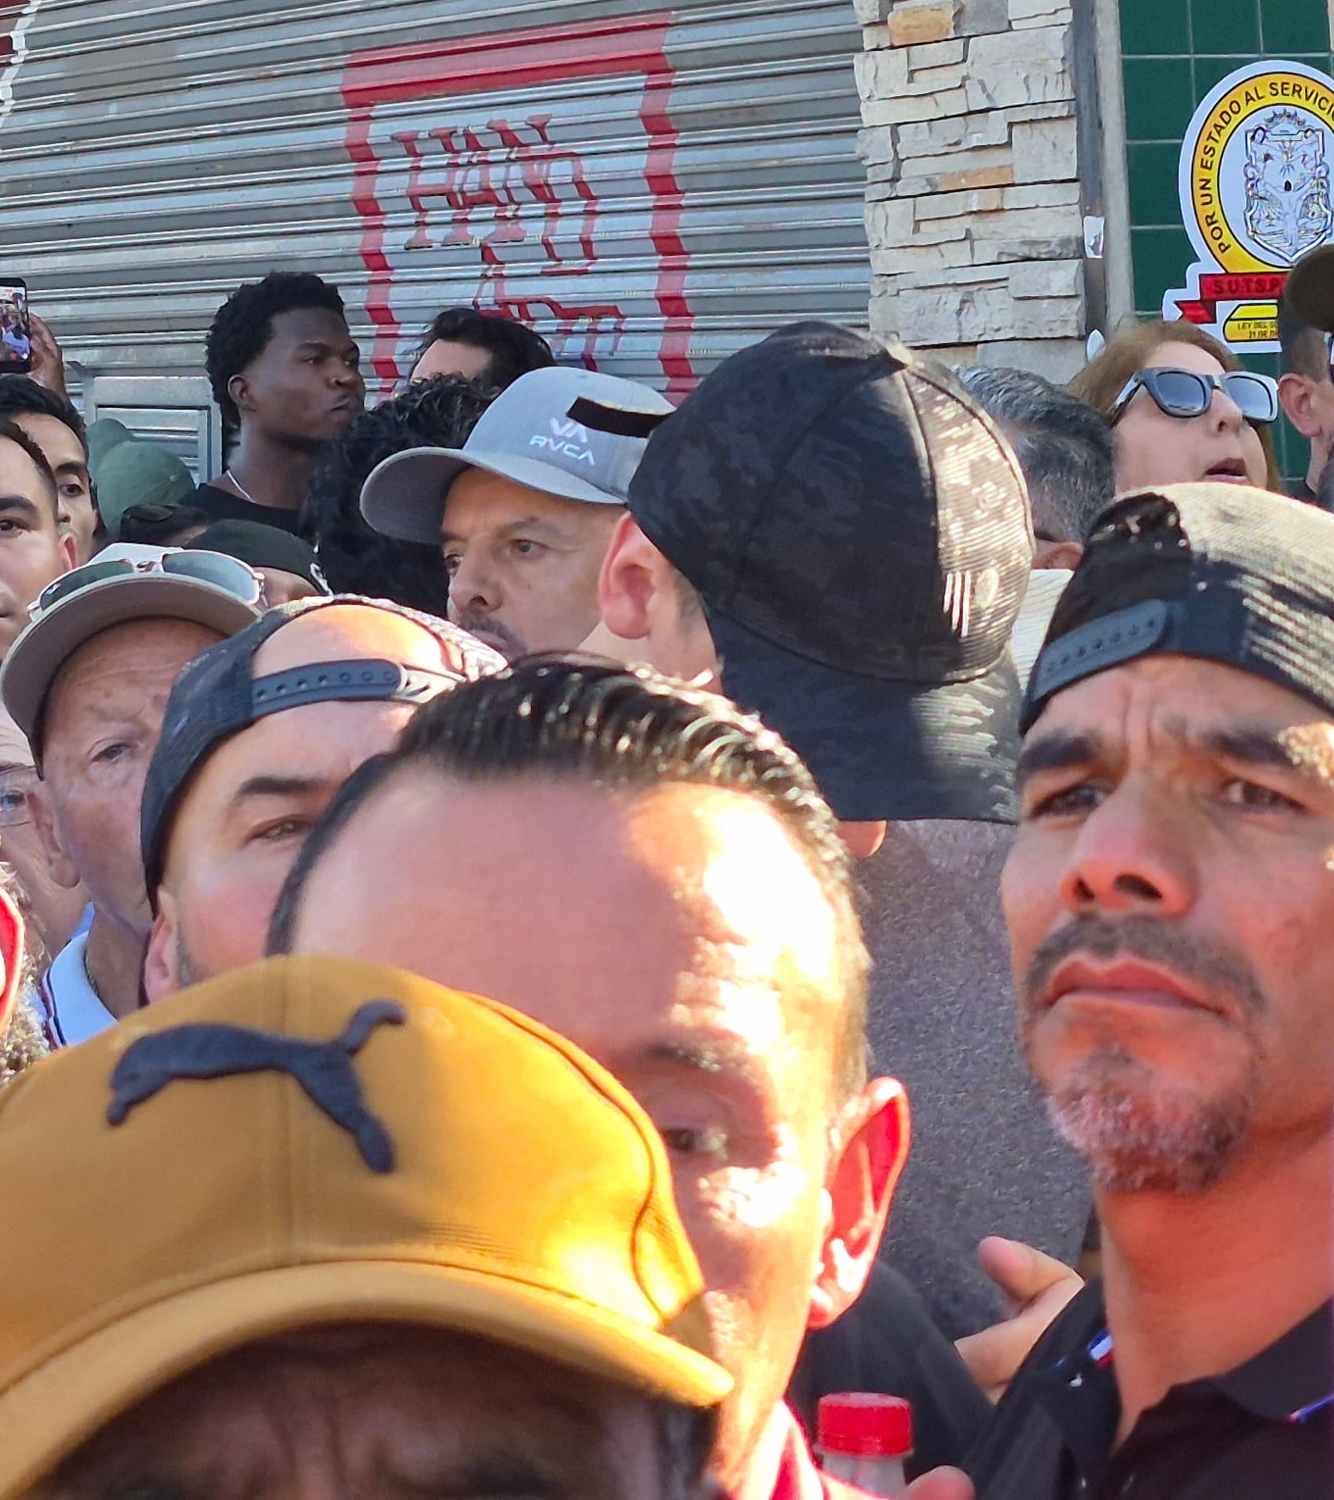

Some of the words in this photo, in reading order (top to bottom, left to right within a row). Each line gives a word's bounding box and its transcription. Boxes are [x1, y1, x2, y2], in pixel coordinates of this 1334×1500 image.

[1244, 86, 1265, 107] AL
[1200, 100, 1242, 171] ESTADO
[1199, 178, 1213, 206] UN
[1205, 211, 1232, 254] POR
[529, 434, 596, 467] RVCA
